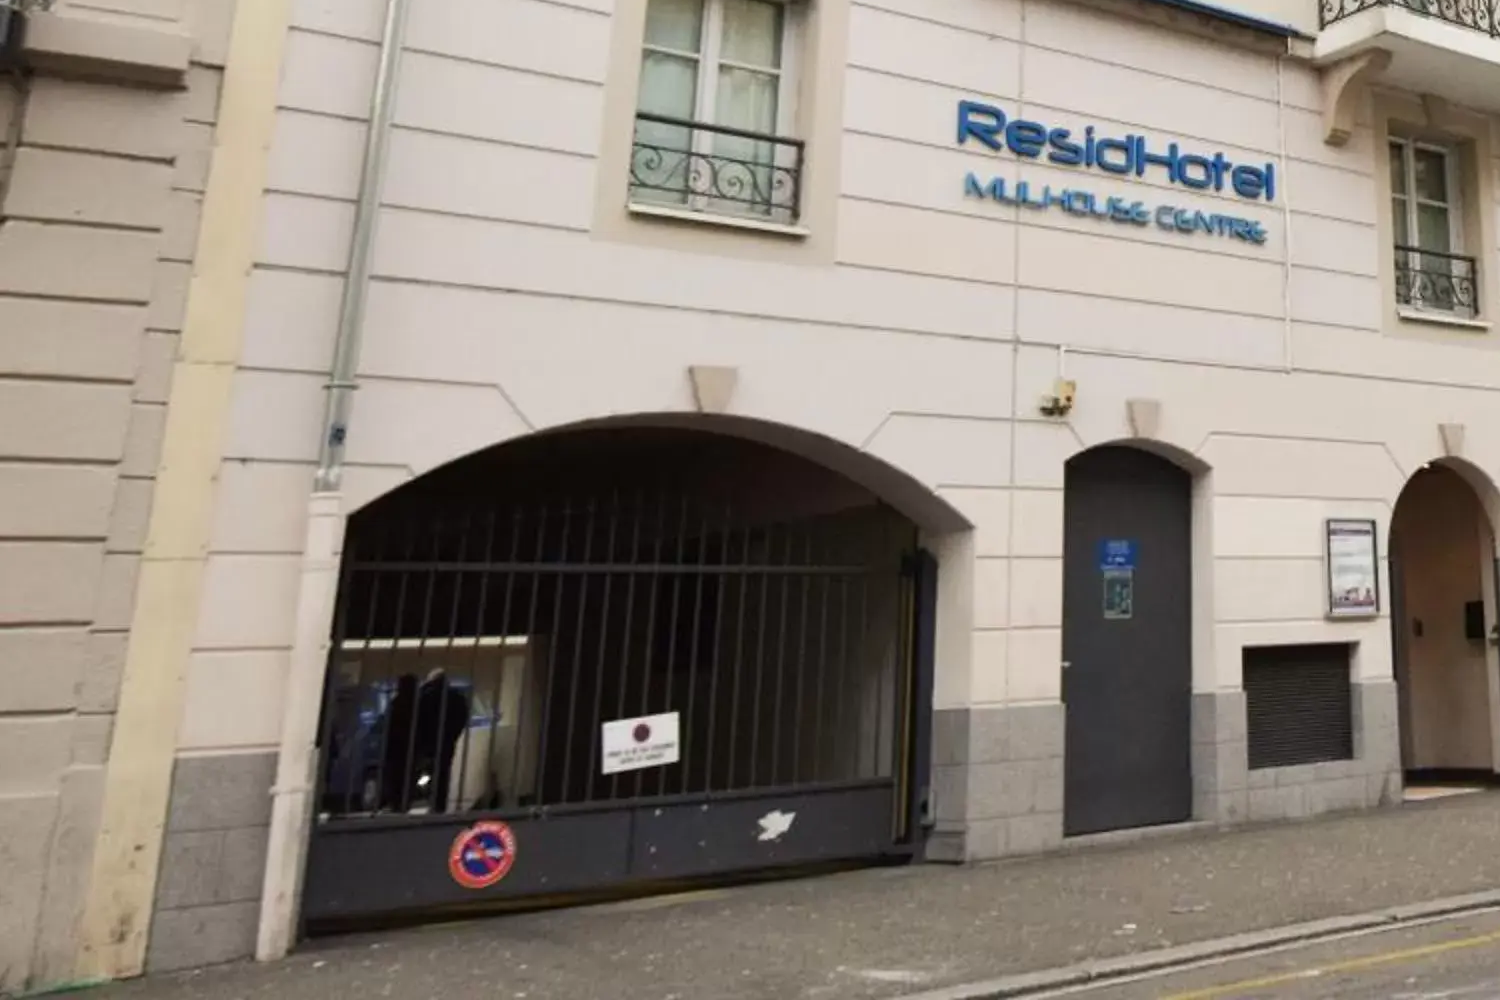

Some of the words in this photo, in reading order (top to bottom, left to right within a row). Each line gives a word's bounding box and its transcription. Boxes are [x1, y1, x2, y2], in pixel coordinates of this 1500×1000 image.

[957, 99, 1275, 201] ResidHotel
[964, 171, 1151, 227] MULHOUSE
[1154, 204, 1268, 246] CENTRE
